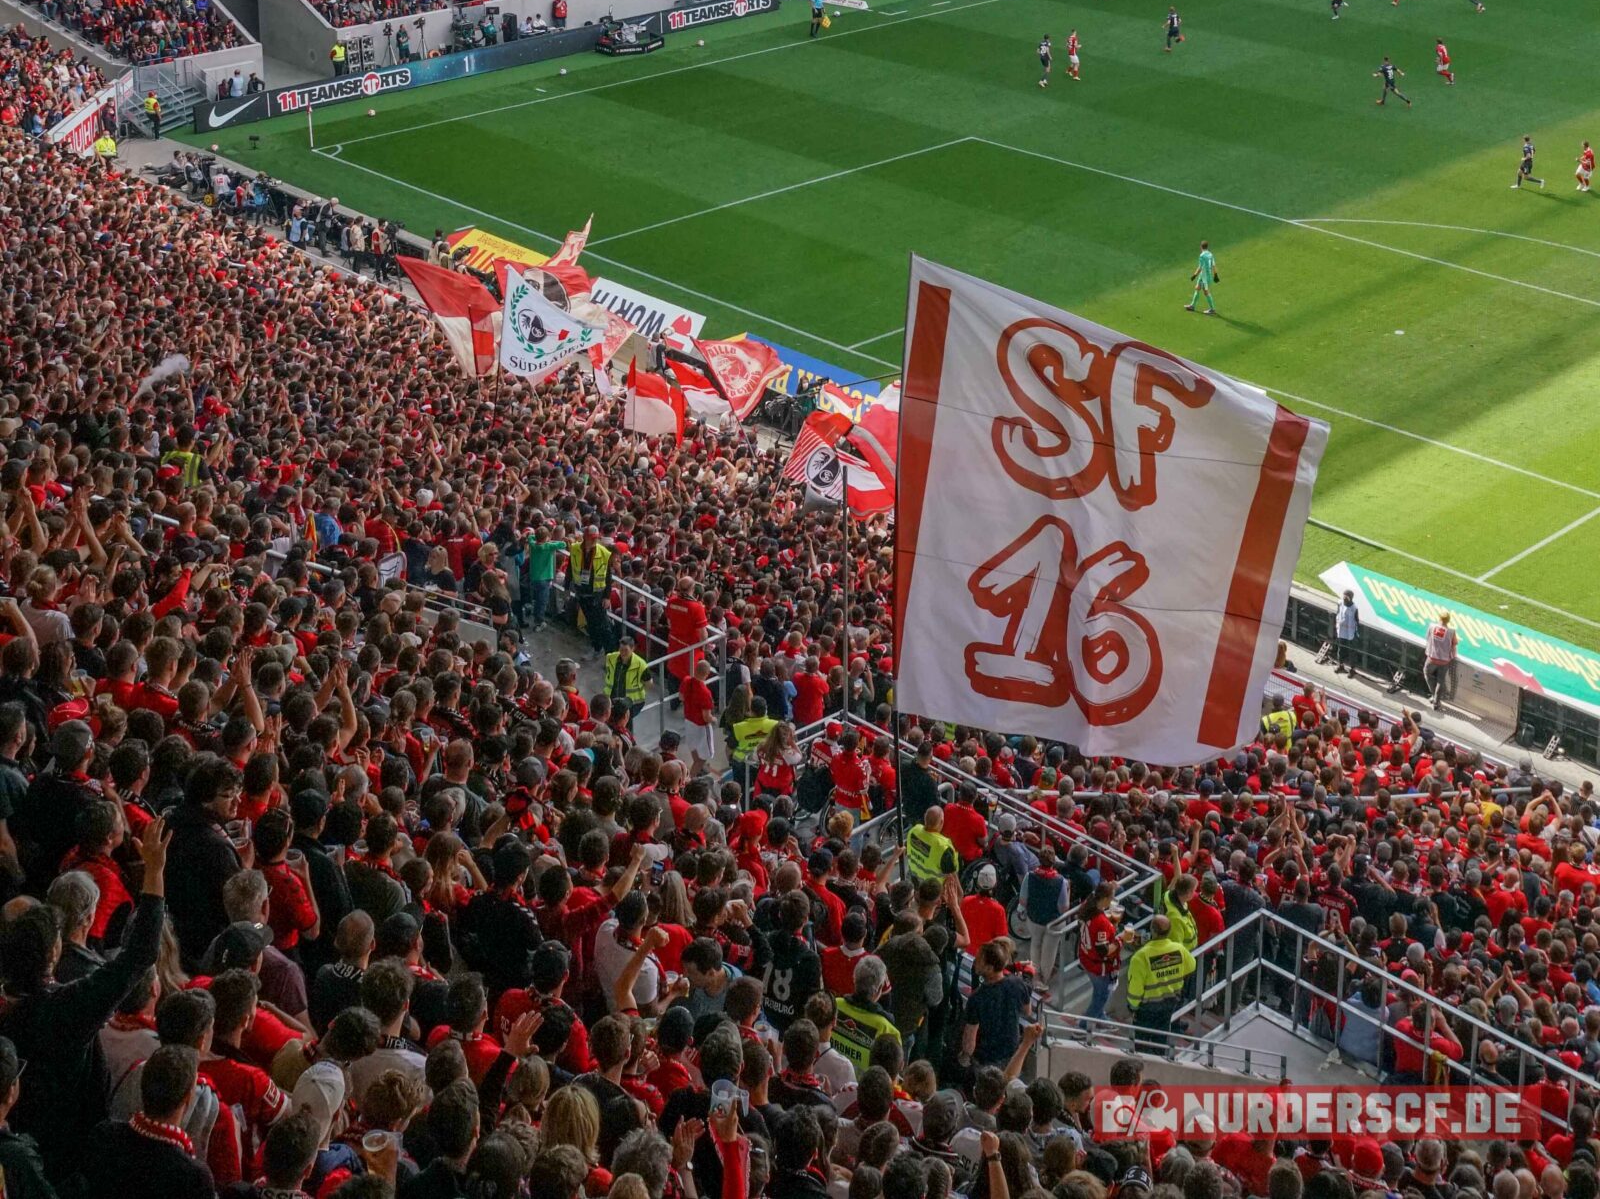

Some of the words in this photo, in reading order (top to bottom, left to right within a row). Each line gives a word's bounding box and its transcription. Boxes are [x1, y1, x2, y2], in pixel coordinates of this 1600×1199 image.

[509, 342, 586, 373] SÜDBADEN
[991, 318, 1216, 511] SF
[964, 514, 1163, 727] 16
[1156, 967, 1180, 979] ORDNER
